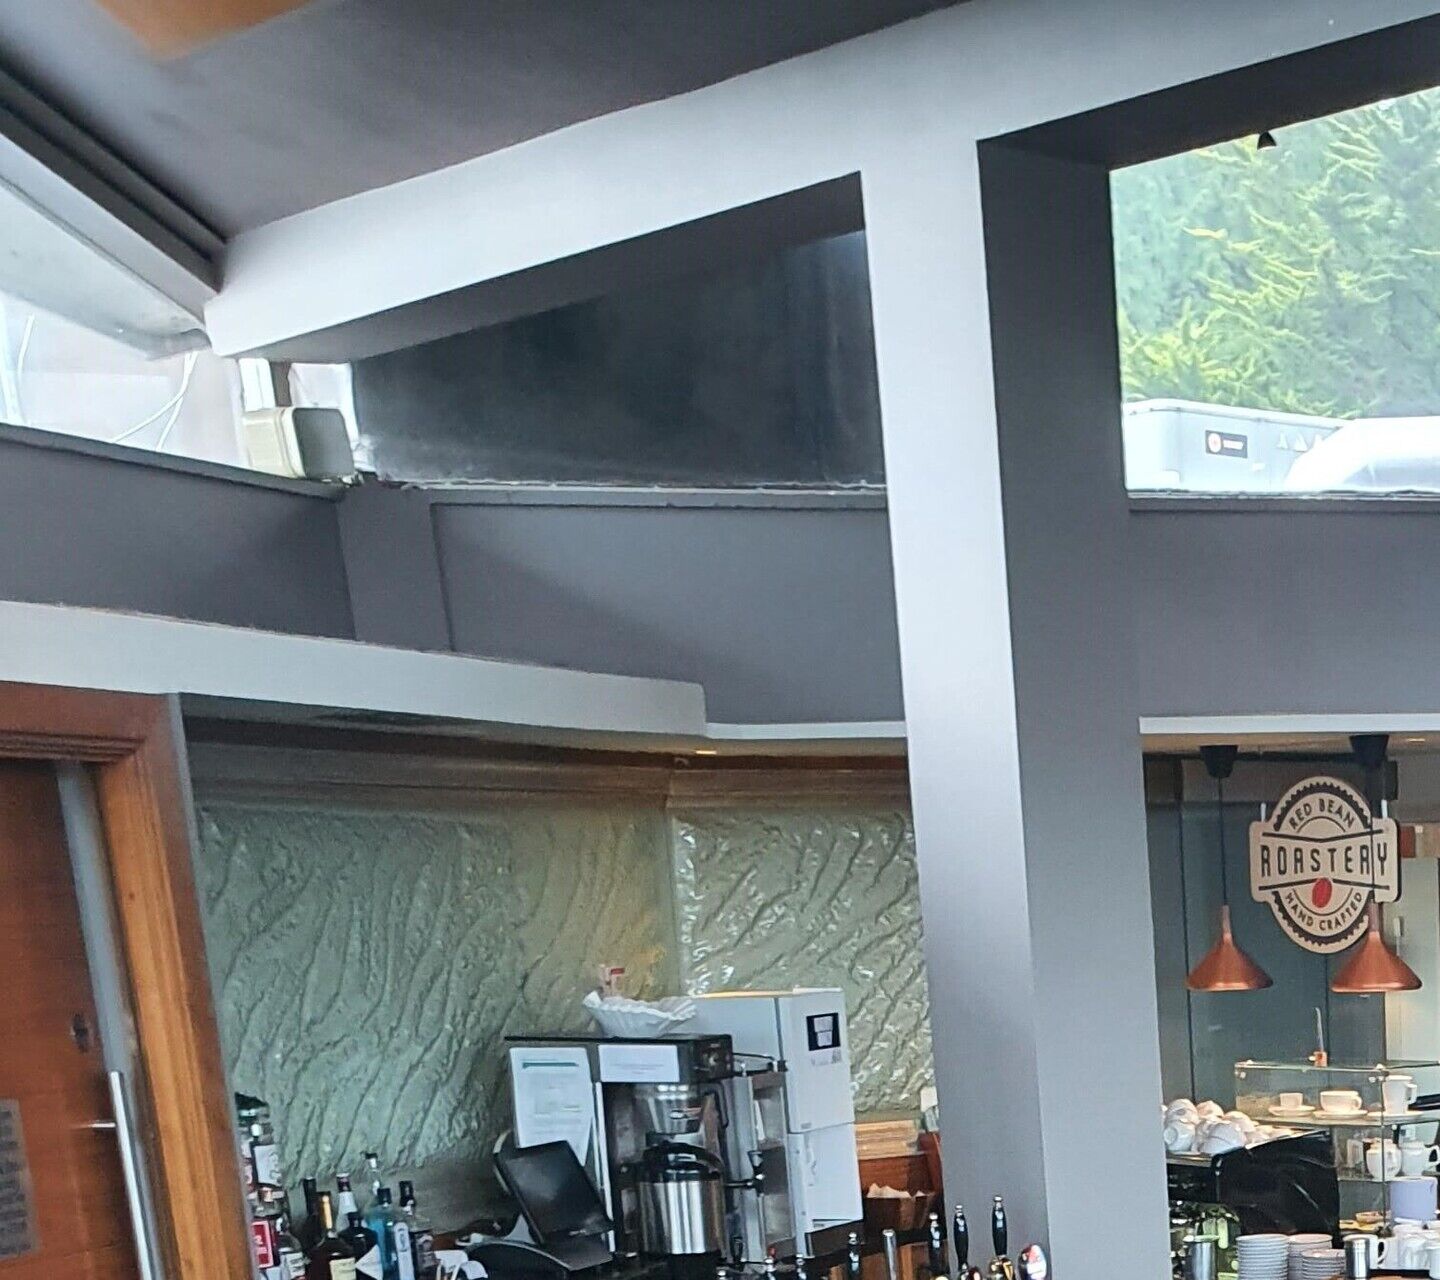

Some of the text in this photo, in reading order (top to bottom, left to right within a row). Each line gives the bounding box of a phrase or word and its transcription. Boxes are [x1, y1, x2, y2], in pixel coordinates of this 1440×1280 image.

[1288, 798, 1356, 830] RED BEAN
[1260, 842, 1388, 878] ROASTERY
[1285, 891, 1363, 931] HAND CRAFTED
